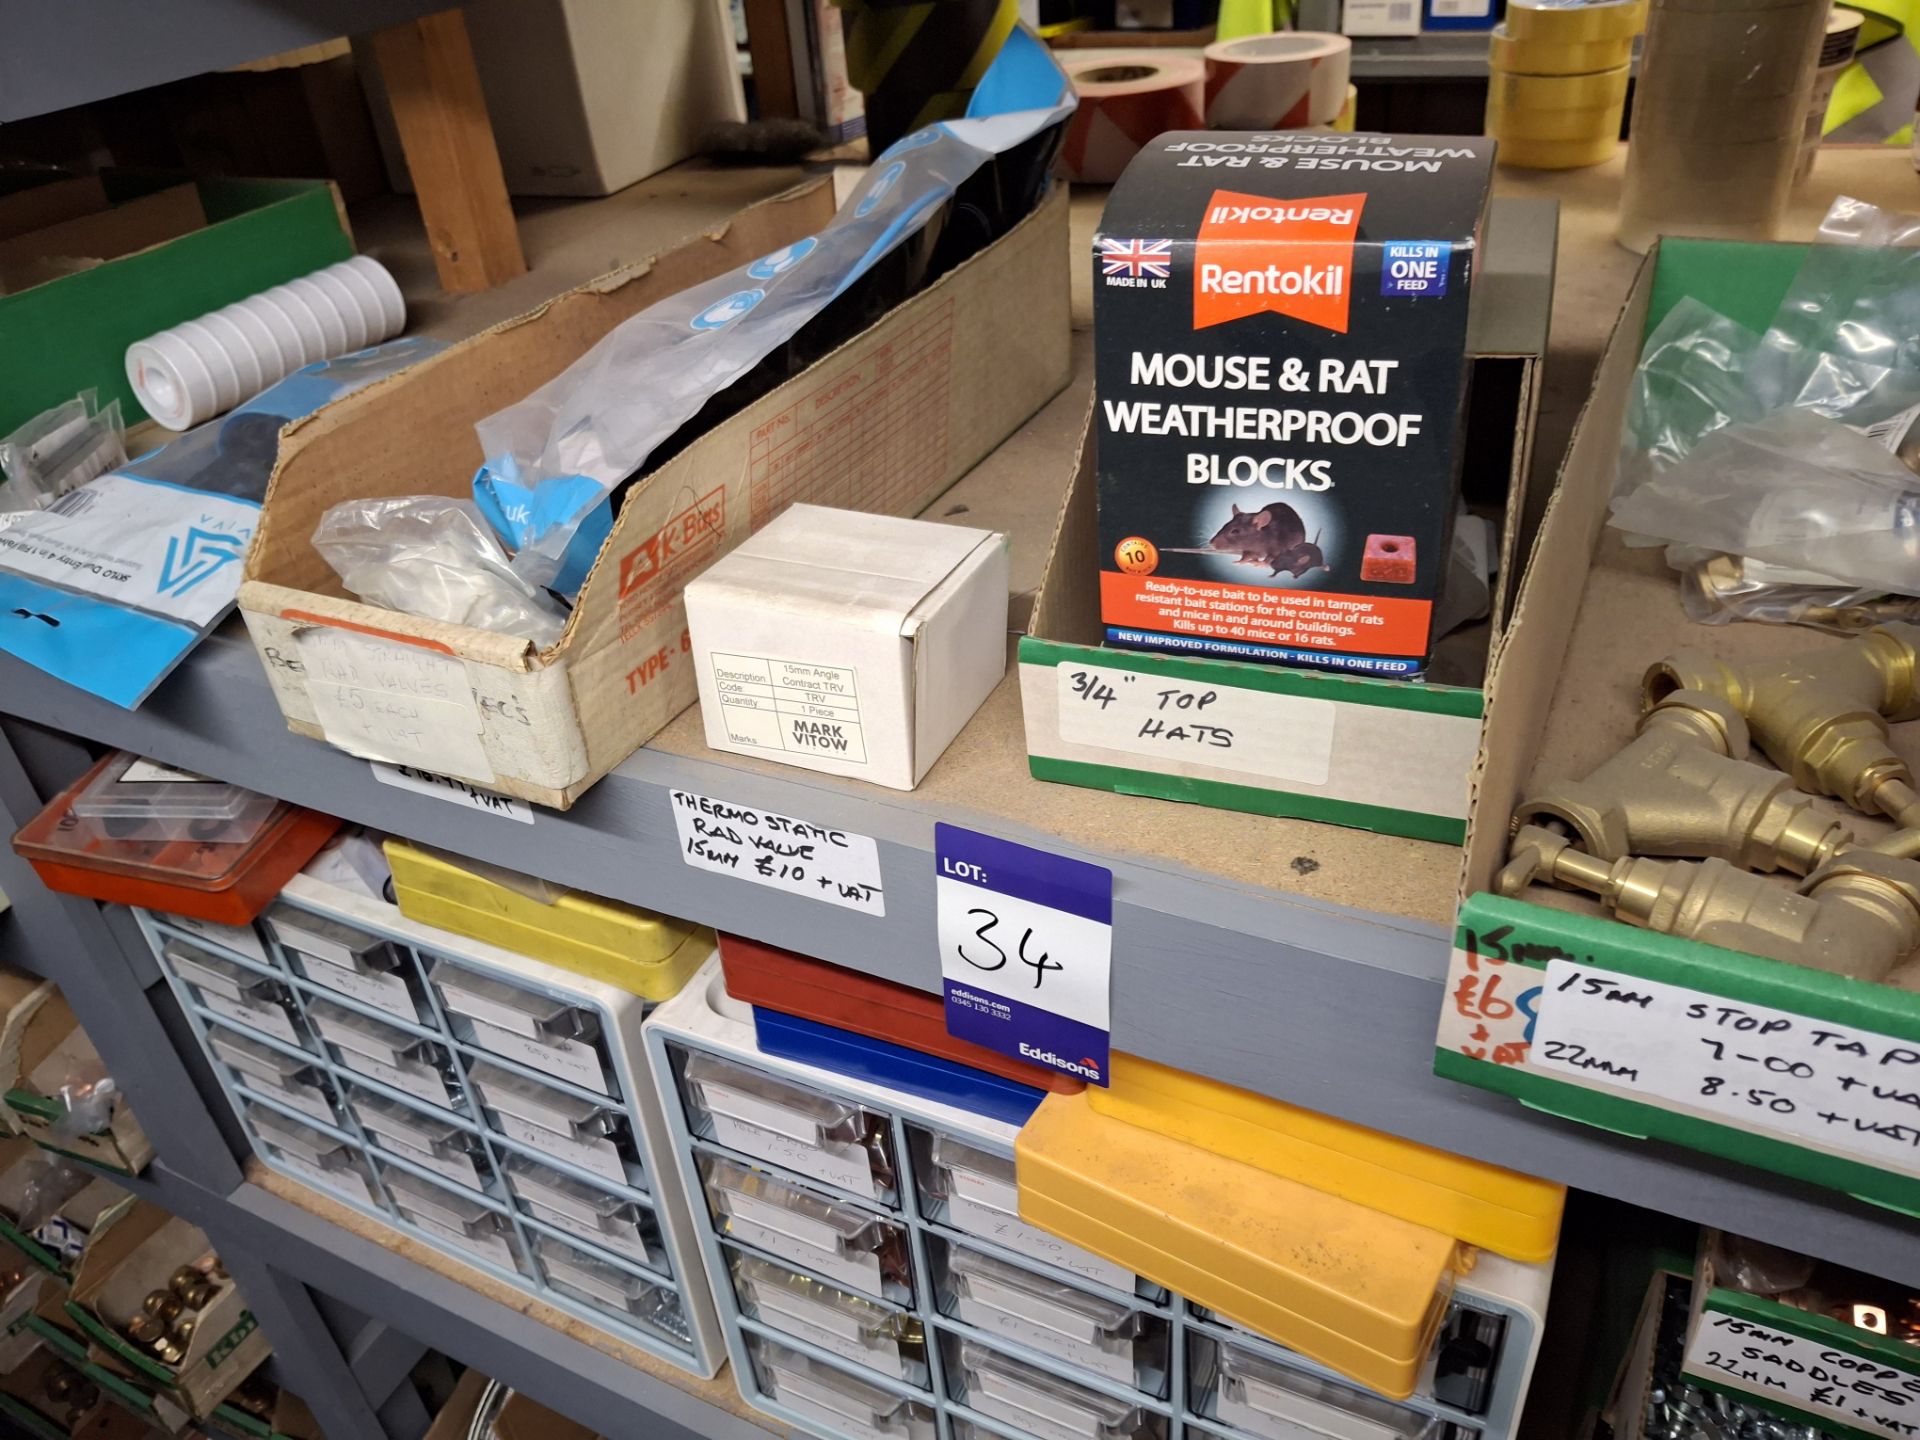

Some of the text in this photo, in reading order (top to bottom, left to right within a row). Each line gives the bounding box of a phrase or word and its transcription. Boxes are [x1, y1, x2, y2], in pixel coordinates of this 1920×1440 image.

[1164, 141, 1477, 159] WEATHERPROOF
[1251, 135, 1392, 145] BLOCKS
[1177, 155, 1443, 173] MOUSE & RAT
[1210, 205, 1354, 225] Rentokil
[1389, 245, 1438, 258] KILLS IN
[1200, 263, 1344, 296] Rentokil
[1390, 260, 1438, 279] ONE
[1106, 276, 1167, 289] MADE IN UK
[1396, 279, 1428, 290] FEED
[1130, 351, 1399, 394] MOUSE & RAT
[1103, 400, 1423, 447] WEATHERPROOF
[1187, 453, 1333, 491] BLOCKS
[39, 550, 49, 559] in
[47, 552, 56, 560] 4
[56, 555, 82, 570] Entry
[1125, 550, 1145, 565] 10
[1145, 581, 1374, 613] Ready-to-use bait to be used in tamper
[1135, 593, 1384, 625] resistant bait stations for the control of rats
[1158, 606, 1356, 637] and mice in and around buildings.
[1173, 620, 1337, 646] Kills up to 40 mice or 16 rats.
[1118, 631, 1143, 642] NEW
[1144, 634, 1203, 650] IMPROVED
[1205, 643, 1288, 660] FORMULATION
[1296, 653, 1329, 665] KILLS
[1331, 657, 1345, 666] IN
[1346, 658, 1373, 669] ONE
[1375, 661, 1407, 672] FEED
[625, 644, 670, 696] TYPE
[716, 668, 766, 683] Description
[783, 664, 840, 681] 15mm Angle
[719, 682, 743, 692] Code
[782, 677, 845, 693] Contract TRV
[721, 694, 758, 709] Quantity
[805, 692, 826, 703] TRV
[1157, 690, 1217, 710] TOP
[801, 705, 834, 718] 1 Piece
[793, 719, 844, 739] MARK
[1138, 718, 1234, 748] HATS
[792, 731, 848, 752] VITOW
[674, 792, 849, 848] THERMO STATIC
[693, 817, 815, 861] RAD VALVE
[755, 855, 805, 881] £10
[944, 857, 987, 884] LOT:
[957, 908, 1064, 989] 34
[951, 988, 1011, 1013] eddisons.com
[1453, 974, 1514, 1020] £6
[951, 996, 1012, 1021] 0345 130 3332
[1686, 1003, 1791, 1035] STOP
[1018, 1042, 1100, 1080] Eddisons
[1741, 1346, 1915, 1407] SADDLES
[1810, 1386, 1844, 1408] £1
